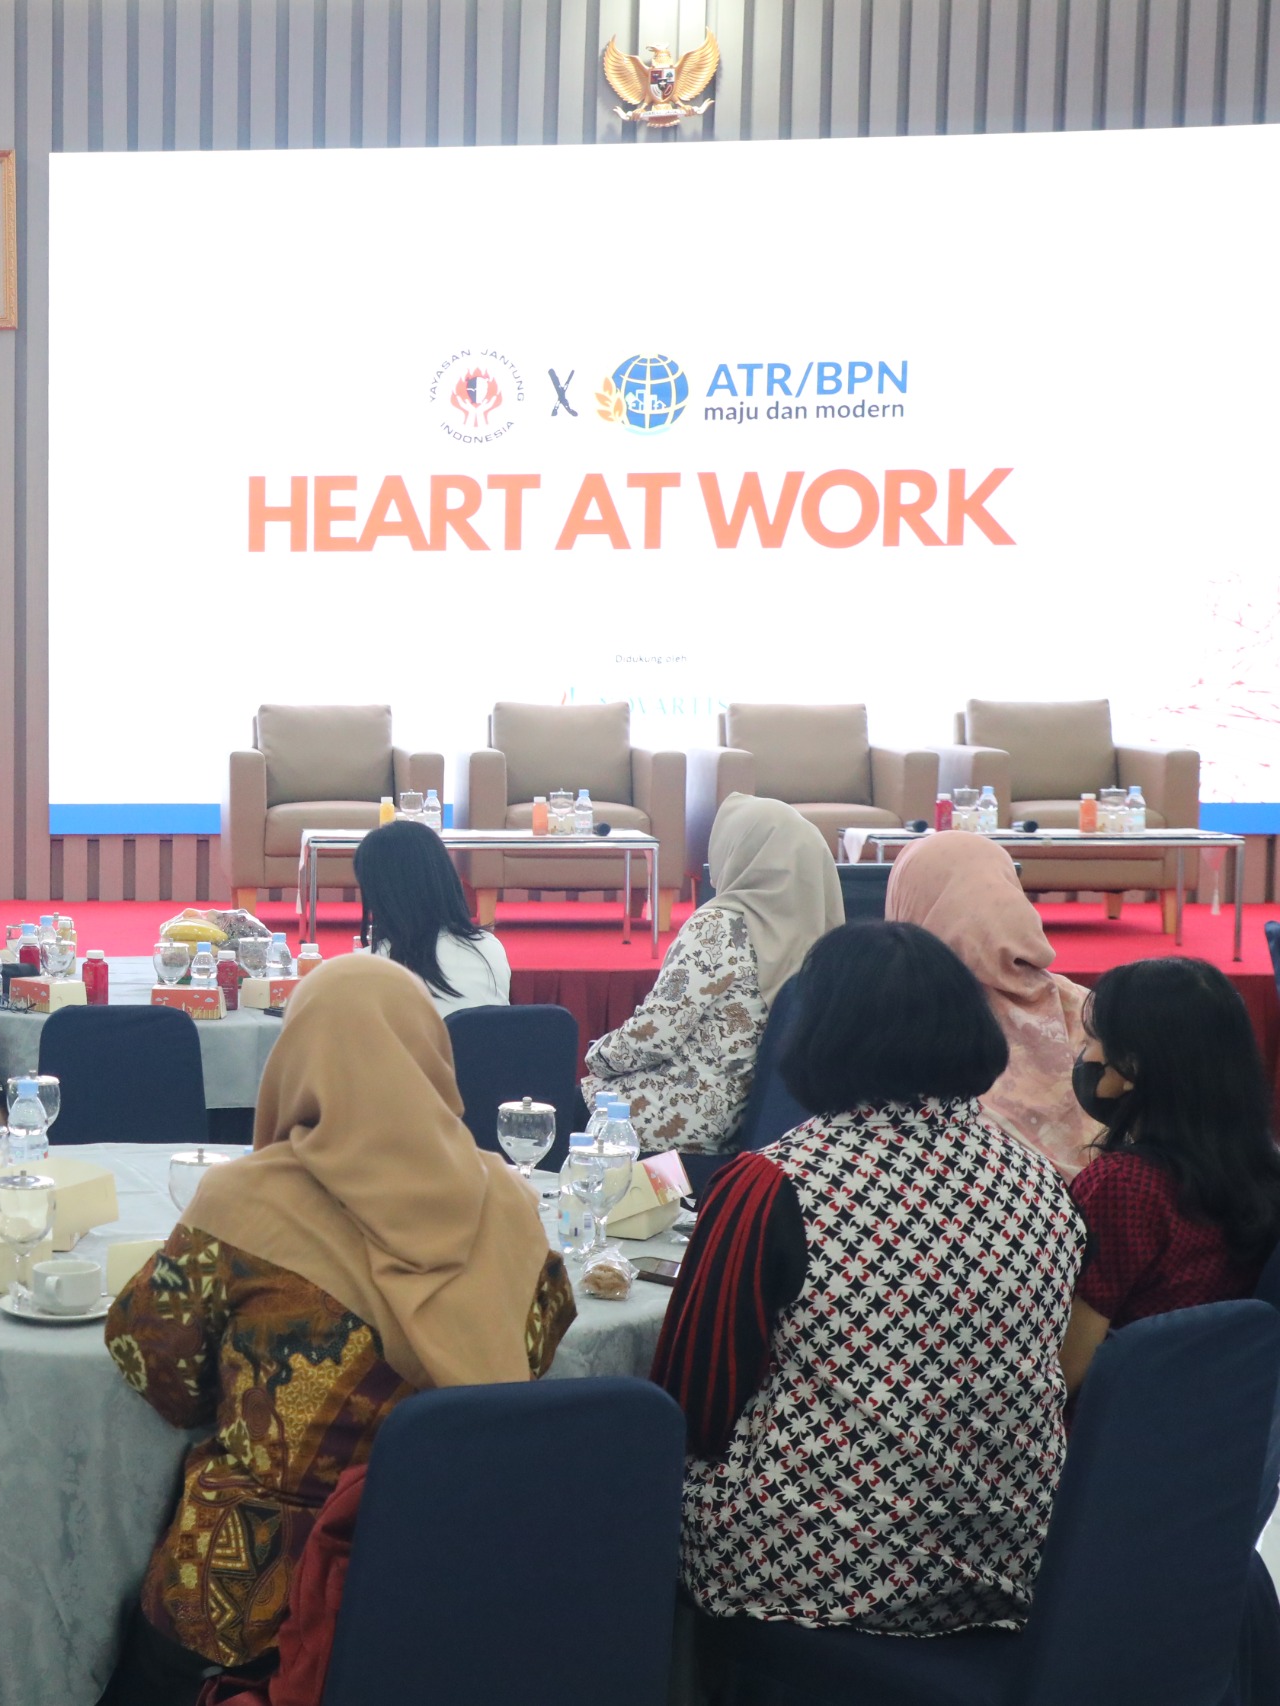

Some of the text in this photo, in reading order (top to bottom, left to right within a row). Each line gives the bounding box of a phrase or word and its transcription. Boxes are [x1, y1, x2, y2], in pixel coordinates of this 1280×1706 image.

[429, 349, 525, 403] YAYASAN JANTUNG
[705, 360, 909, 398] ATR/BPN
[704, 398, 905, 425] maju dan modern
[440, 421, 515, 444] INDONESIA
[247, 467, 1017, 553] HEART AT WORK
